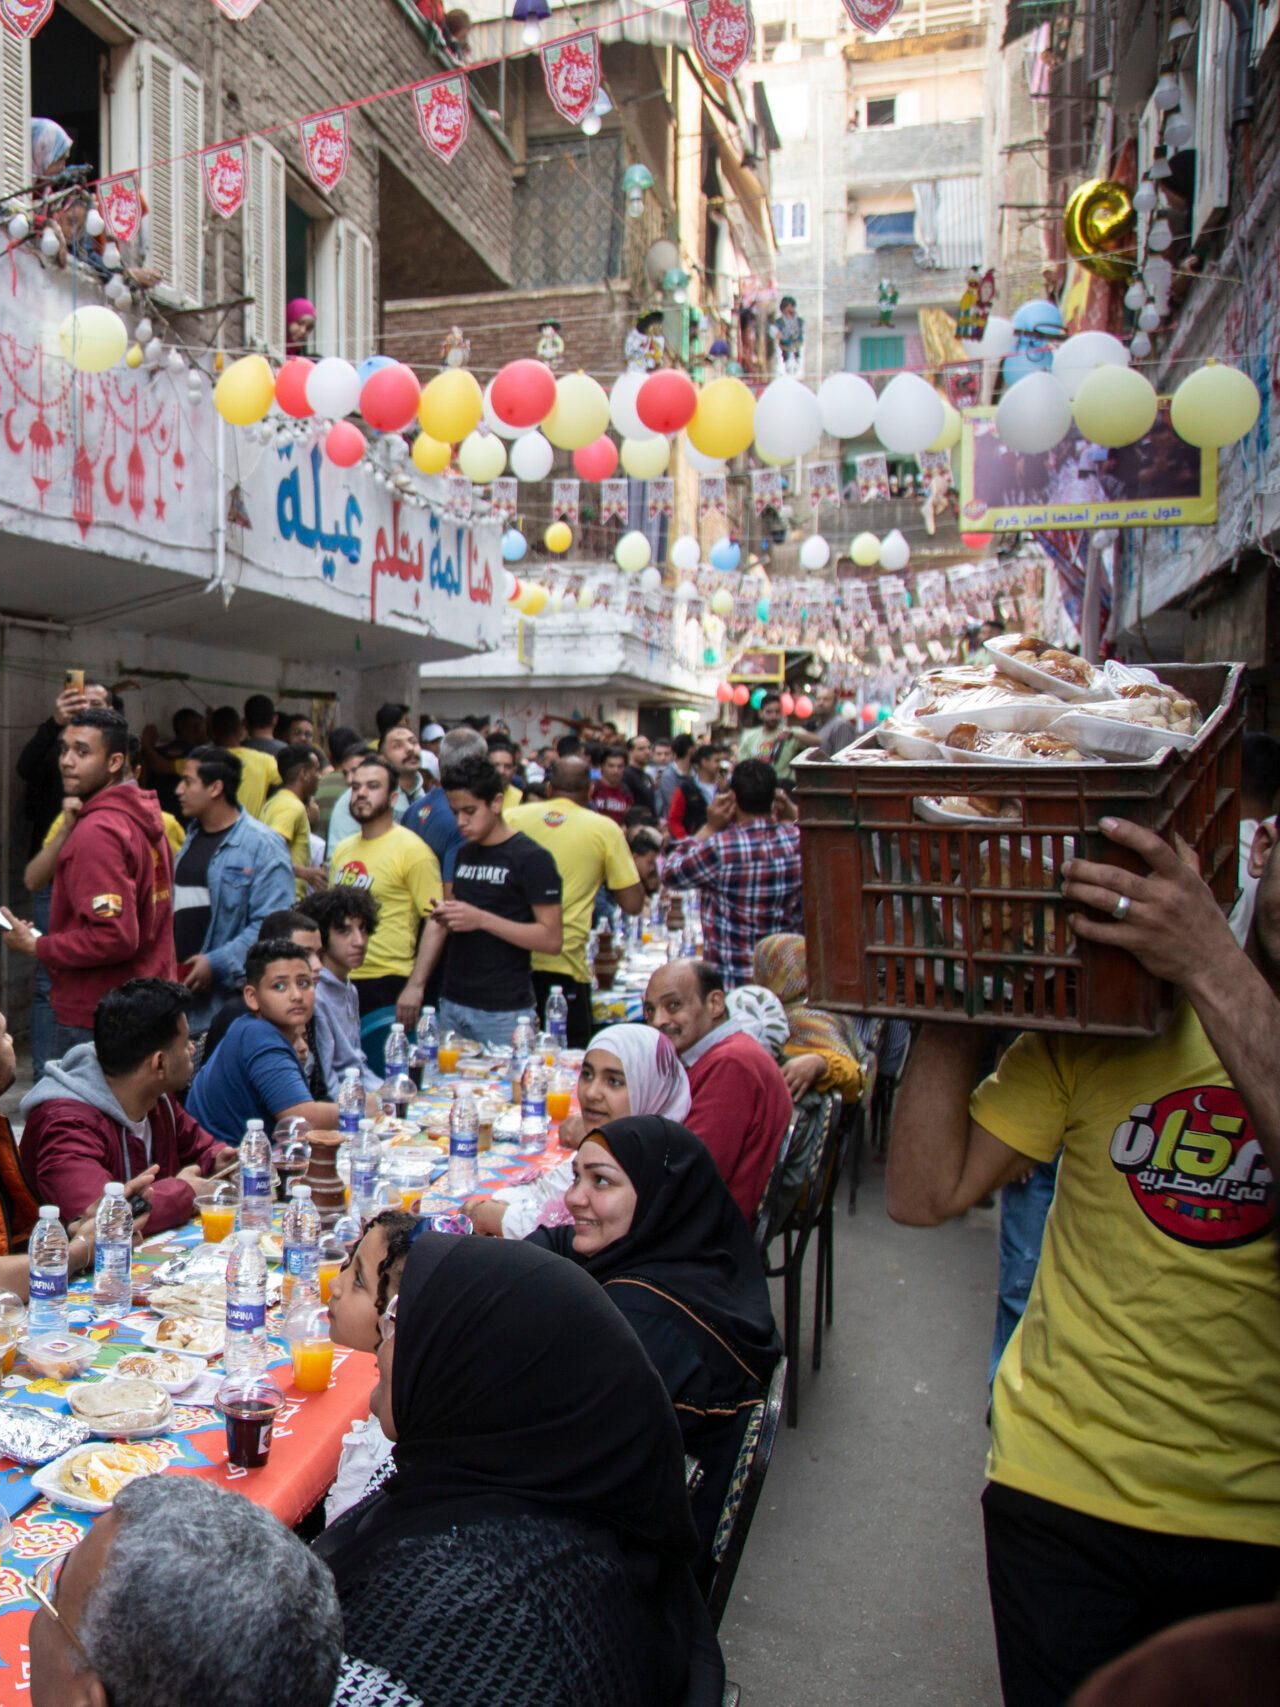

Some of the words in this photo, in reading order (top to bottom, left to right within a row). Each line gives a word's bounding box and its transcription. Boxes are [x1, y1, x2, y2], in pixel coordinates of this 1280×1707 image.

[369, 499, 424, 624] بتلم
[429, 511, 464, 600] لمة
[467, 526, 494, 606] هنا
